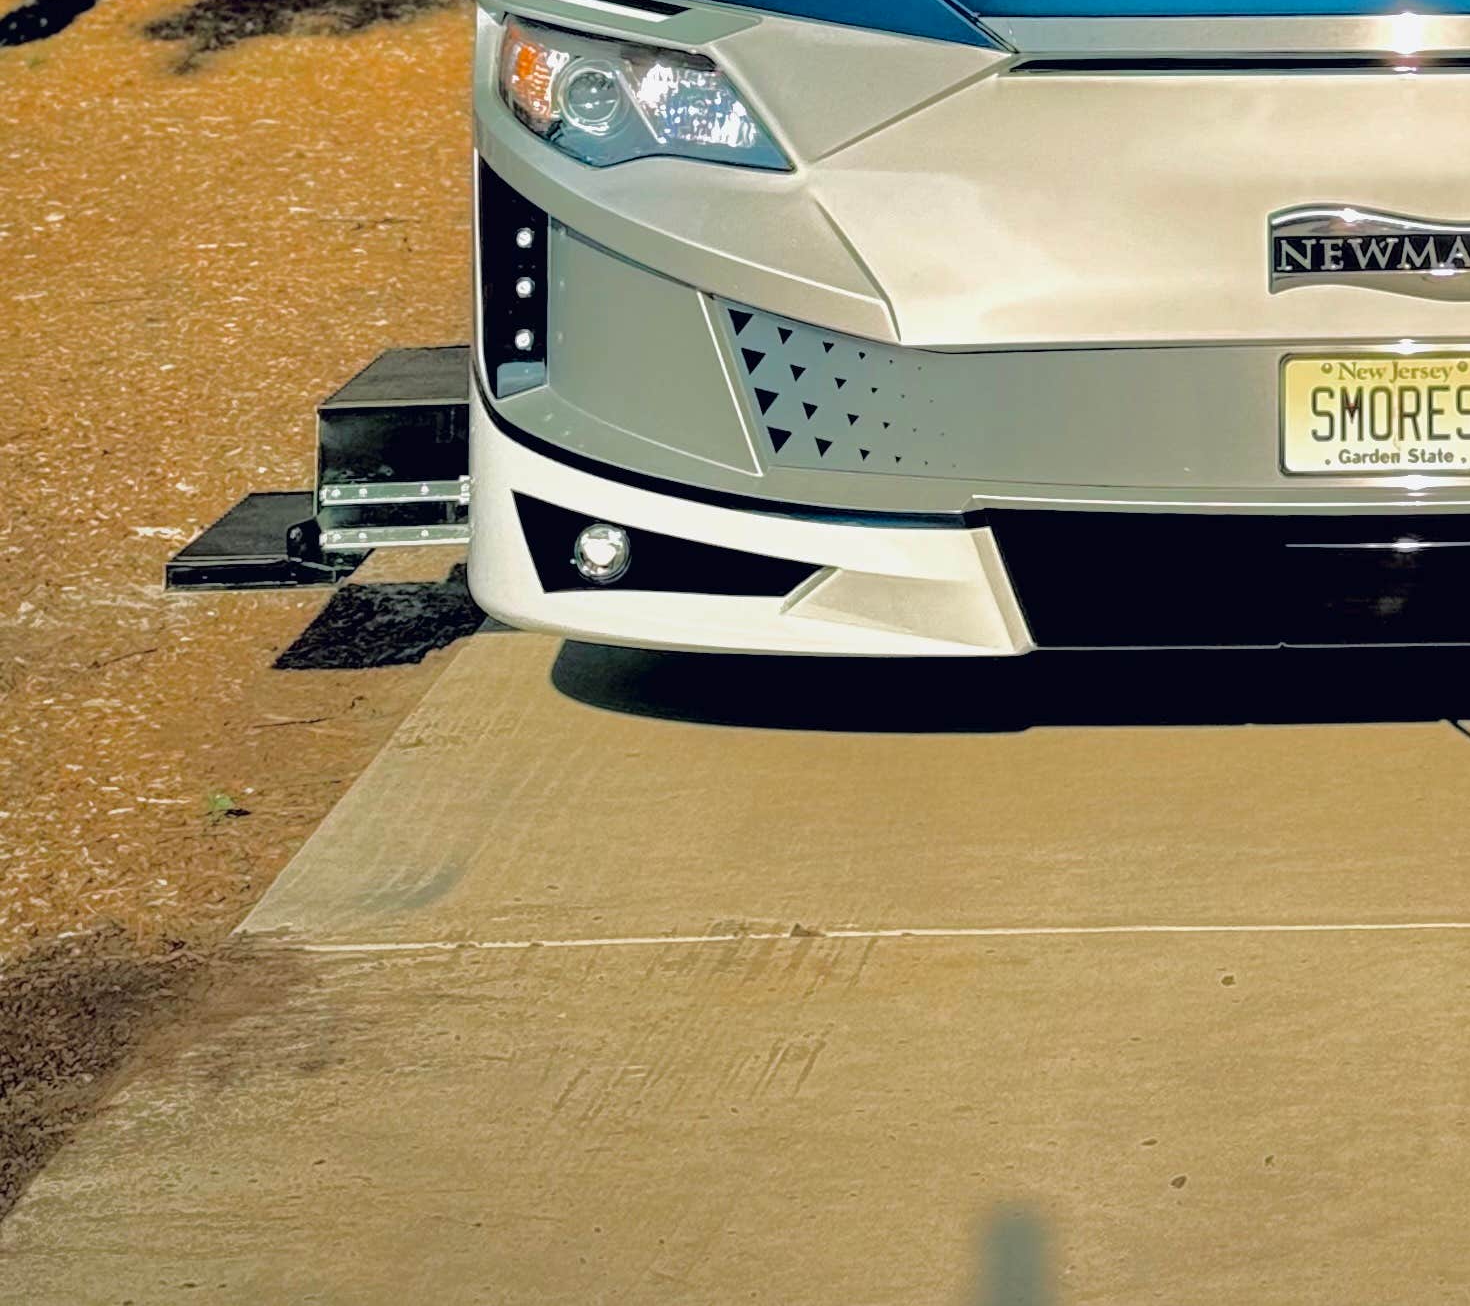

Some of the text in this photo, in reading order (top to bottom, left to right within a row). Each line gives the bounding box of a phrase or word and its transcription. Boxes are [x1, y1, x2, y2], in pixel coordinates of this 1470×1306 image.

[1337, 360, 1453, 384] New Jersey
[1338, 448, 1454, 464] Garden State
